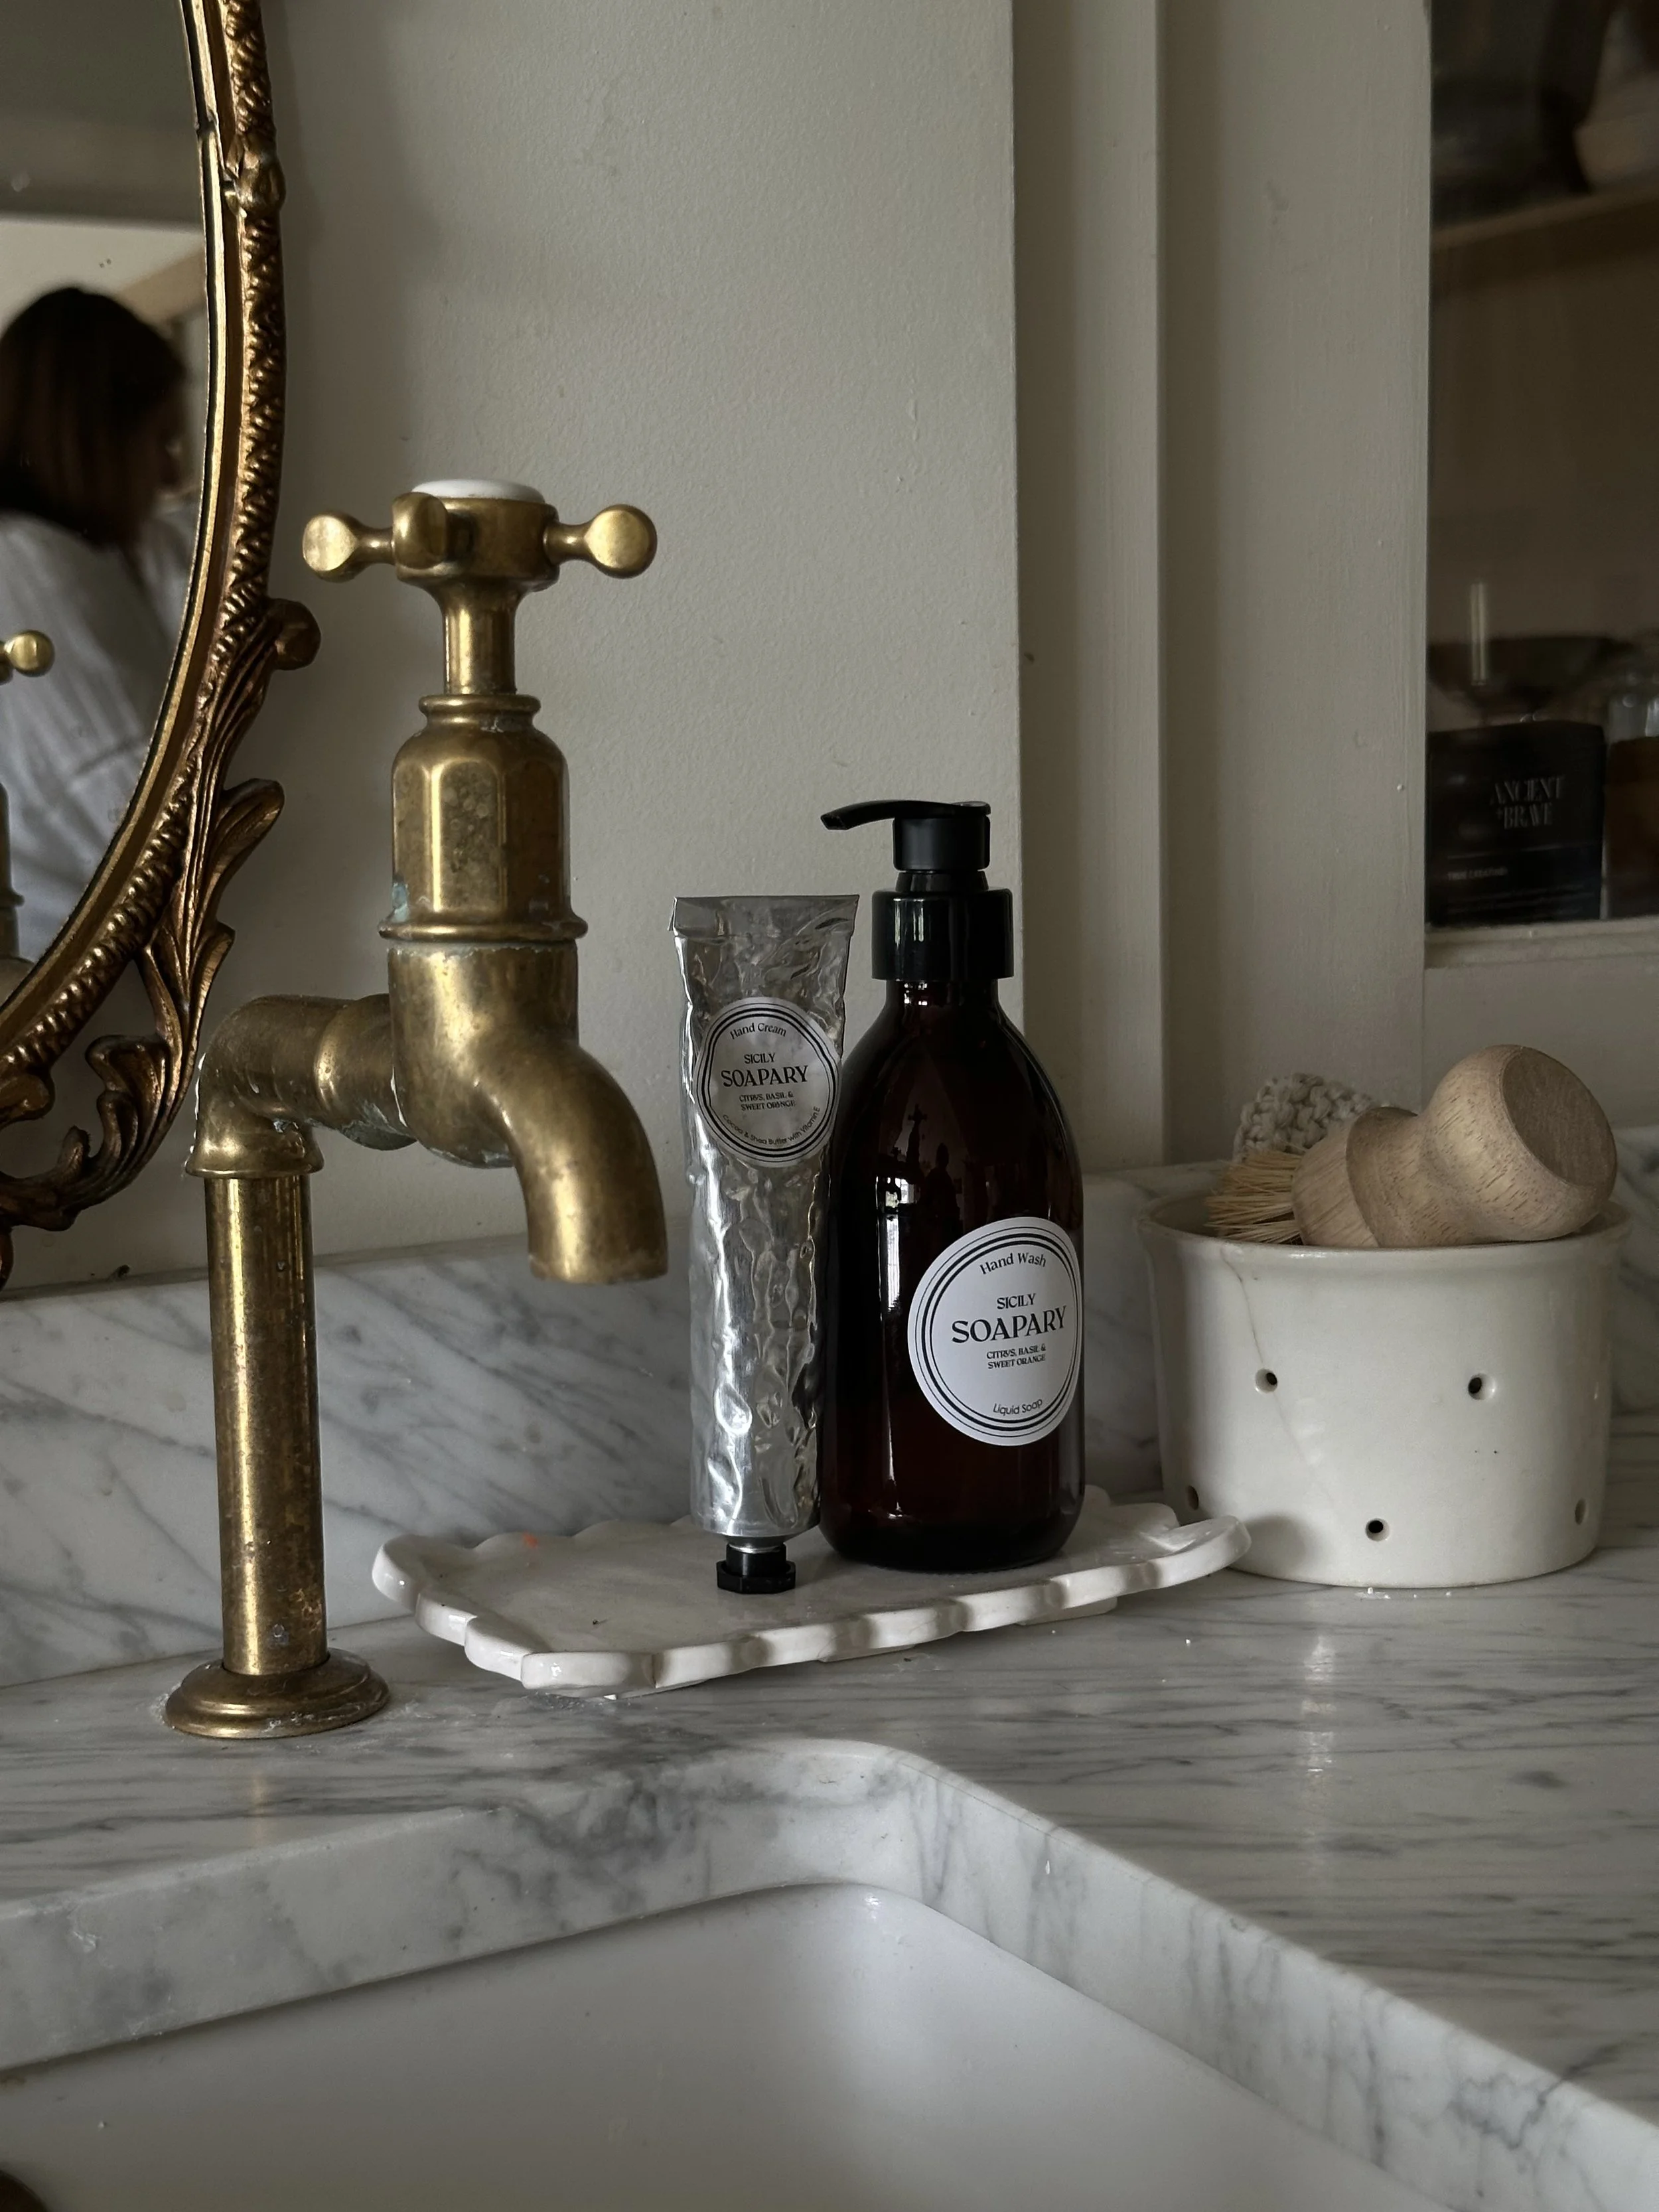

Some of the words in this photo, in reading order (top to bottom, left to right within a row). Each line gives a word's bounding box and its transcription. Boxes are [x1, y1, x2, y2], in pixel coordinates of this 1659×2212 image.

[1490, 775, 1565, 804] ANCIENT
[731, 1023, 755, 1040] Hand
[757, 1023, 787, 1037] Cream
[744, 1053, 776, 1064] SICILY
[721, 1065, 808, 1087] SOAPARY
[766, 1092, 786, 1100] BASIL
[723, 1114, 743, 1134] Cocoa
[750, 1134, 767, 1144] Shea
[788, 1132, 802, 1141] with
[801, 1112, 819, 1132] Vitamin
[979, 1252, 1013, 1275] Hand
[1017, 1252, 1046, 1268] Wash
[996, 1293, 1036, 1310] SICILY
[951, 1305, 1067, 1344] SOAPARY
[1019, 1345, 1039, 1355] BASIL
[987, 1359, 1016, 1369] SWEET
[1017, 1354, 1046, 1366] ORANGE
[993, 1403, 1020, 1416] Liquid
[1022, 1398, 1043, 1414] Soap
